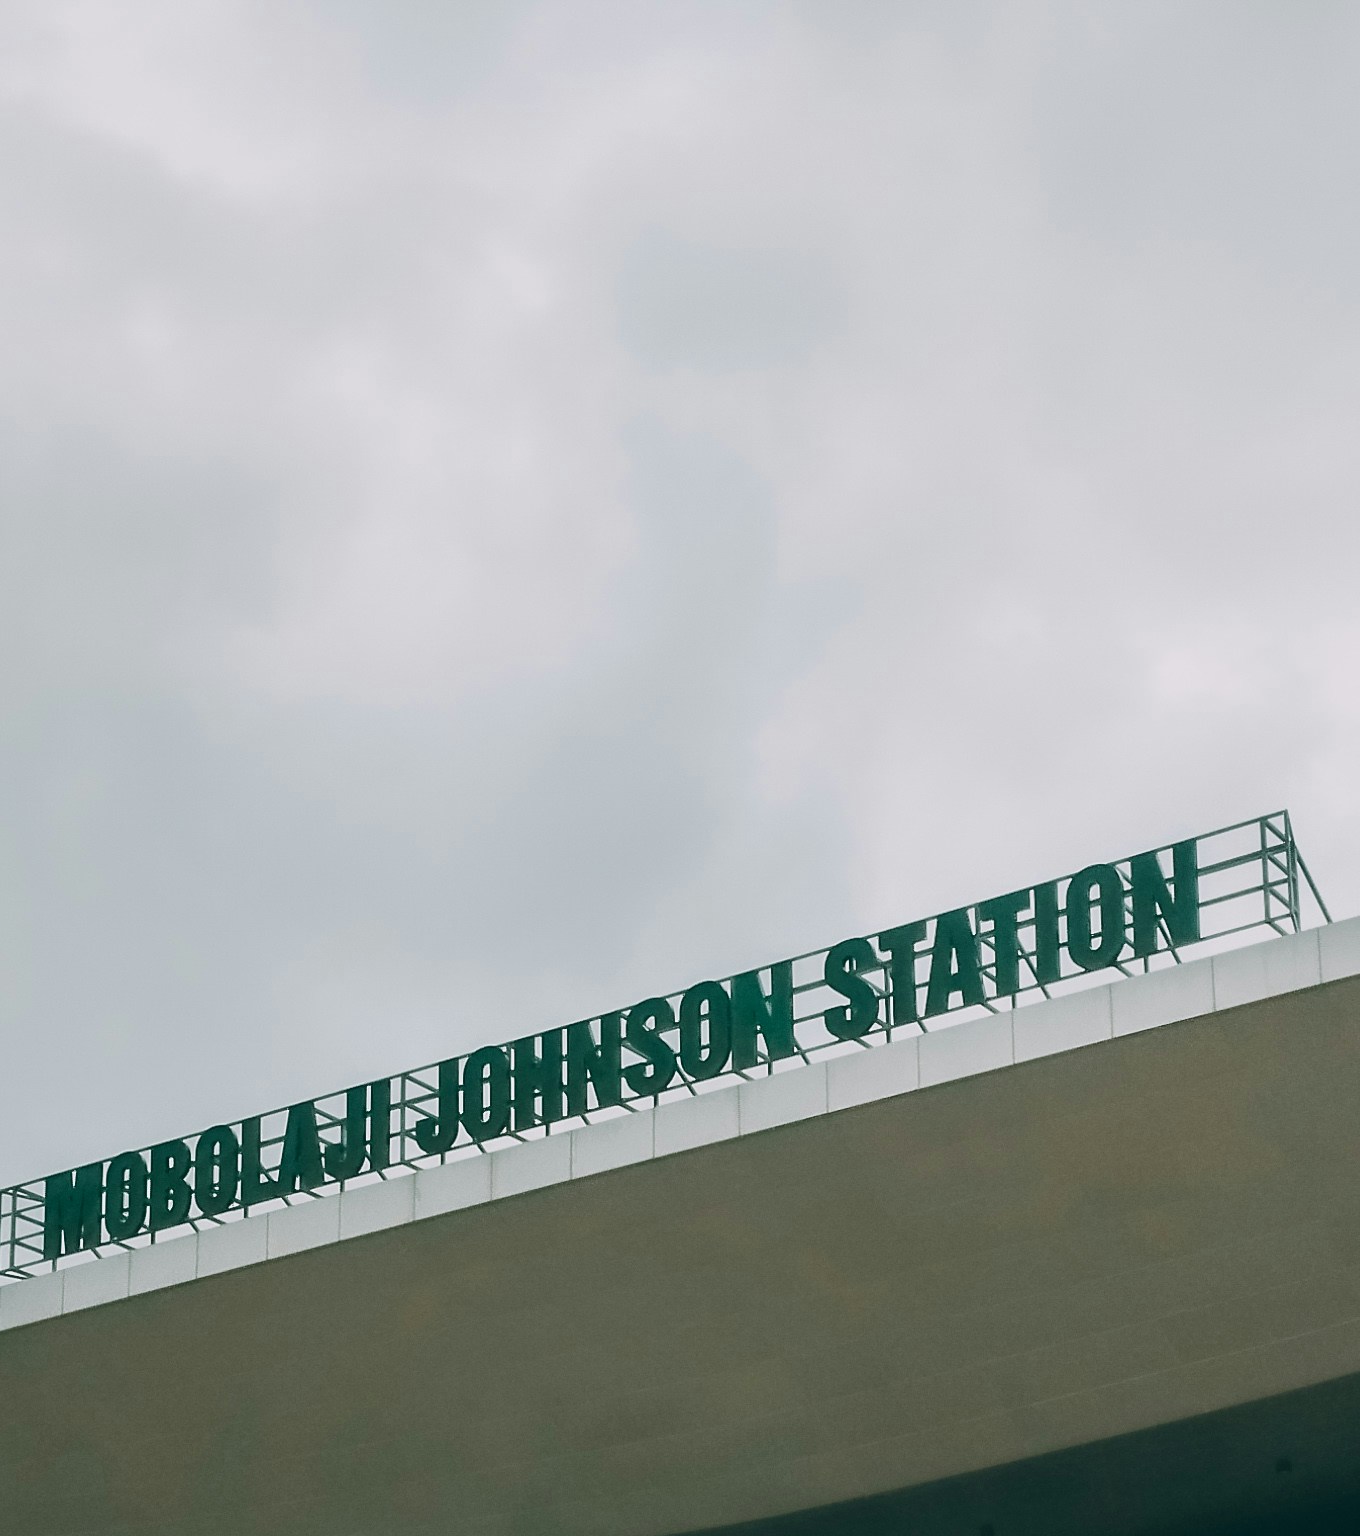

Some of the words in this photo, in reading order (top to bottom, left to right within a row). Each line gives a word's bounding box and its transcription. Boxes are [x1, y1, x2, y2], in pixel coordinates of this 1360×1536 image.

[43, 1078, 391, 1260] MOBOLAJI
[415, 960, 796, 1155] JOHNSON
[824, 838, 1200, 1040] STATION
